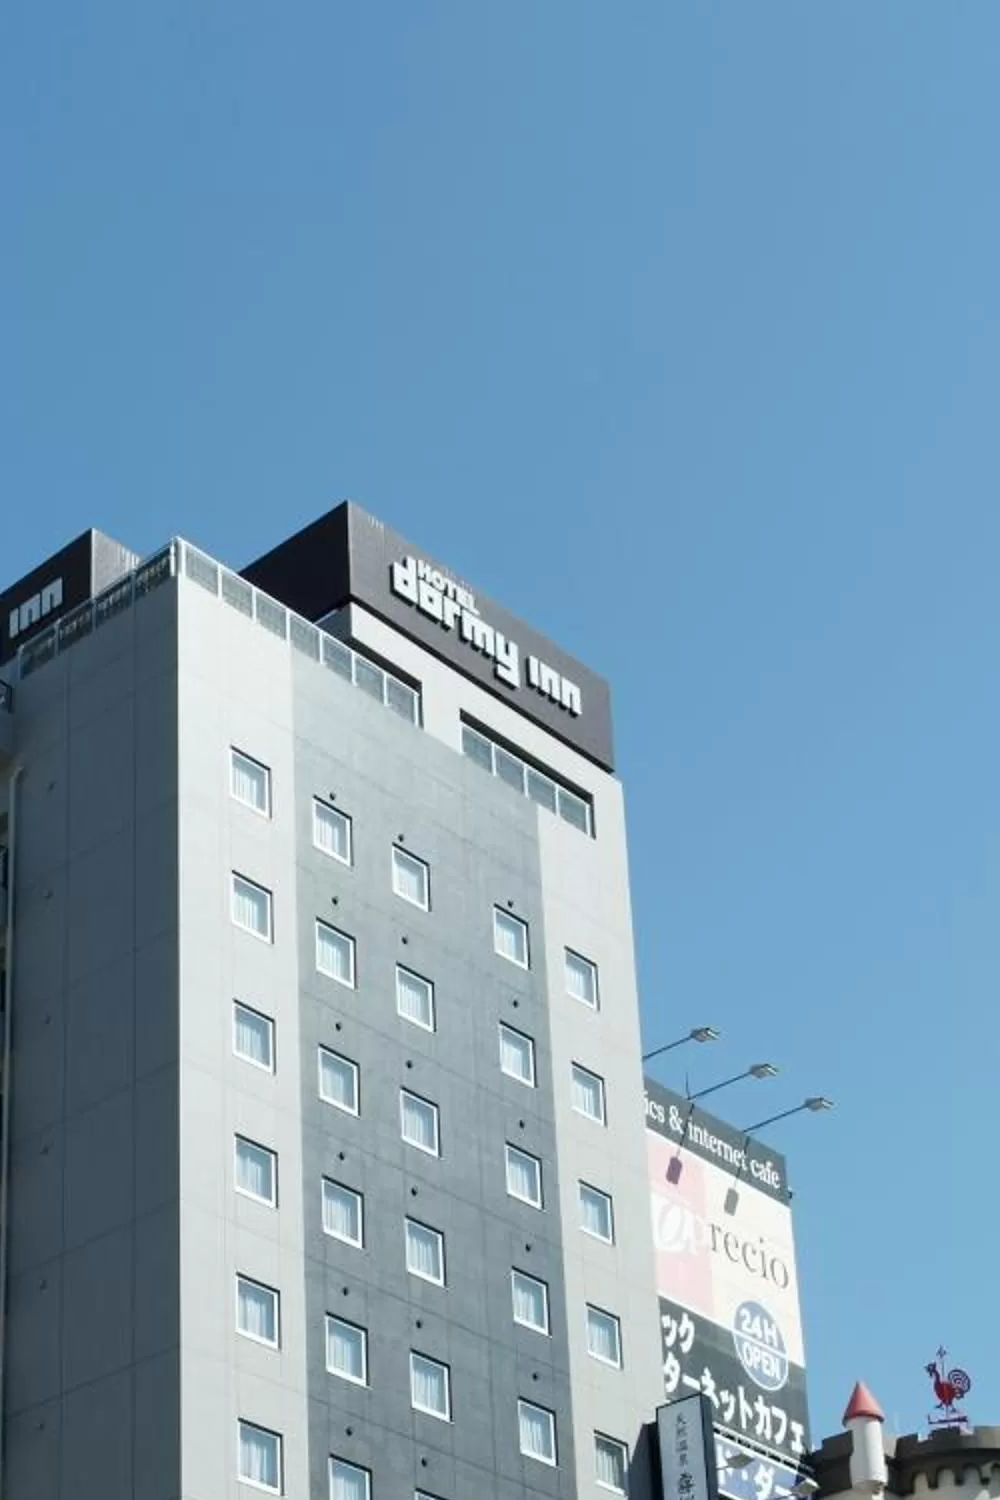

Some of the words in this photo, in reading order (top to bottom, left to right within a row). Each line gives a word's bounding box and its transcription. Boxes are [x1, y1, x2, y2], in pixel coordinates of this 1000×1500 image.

[9, 577, 64, 639] inn
[416, 559, 479, 616] HOTEL
[392, 555, 520, 689] dormy
[528, 655, 583, 716] inn
[669, 1104, 685, 1135] &
[687, 1115, 748, 1172] internet
[738, 1307, 778, 1348] 24H
[741, 1342, 782, 1382] OPEN
